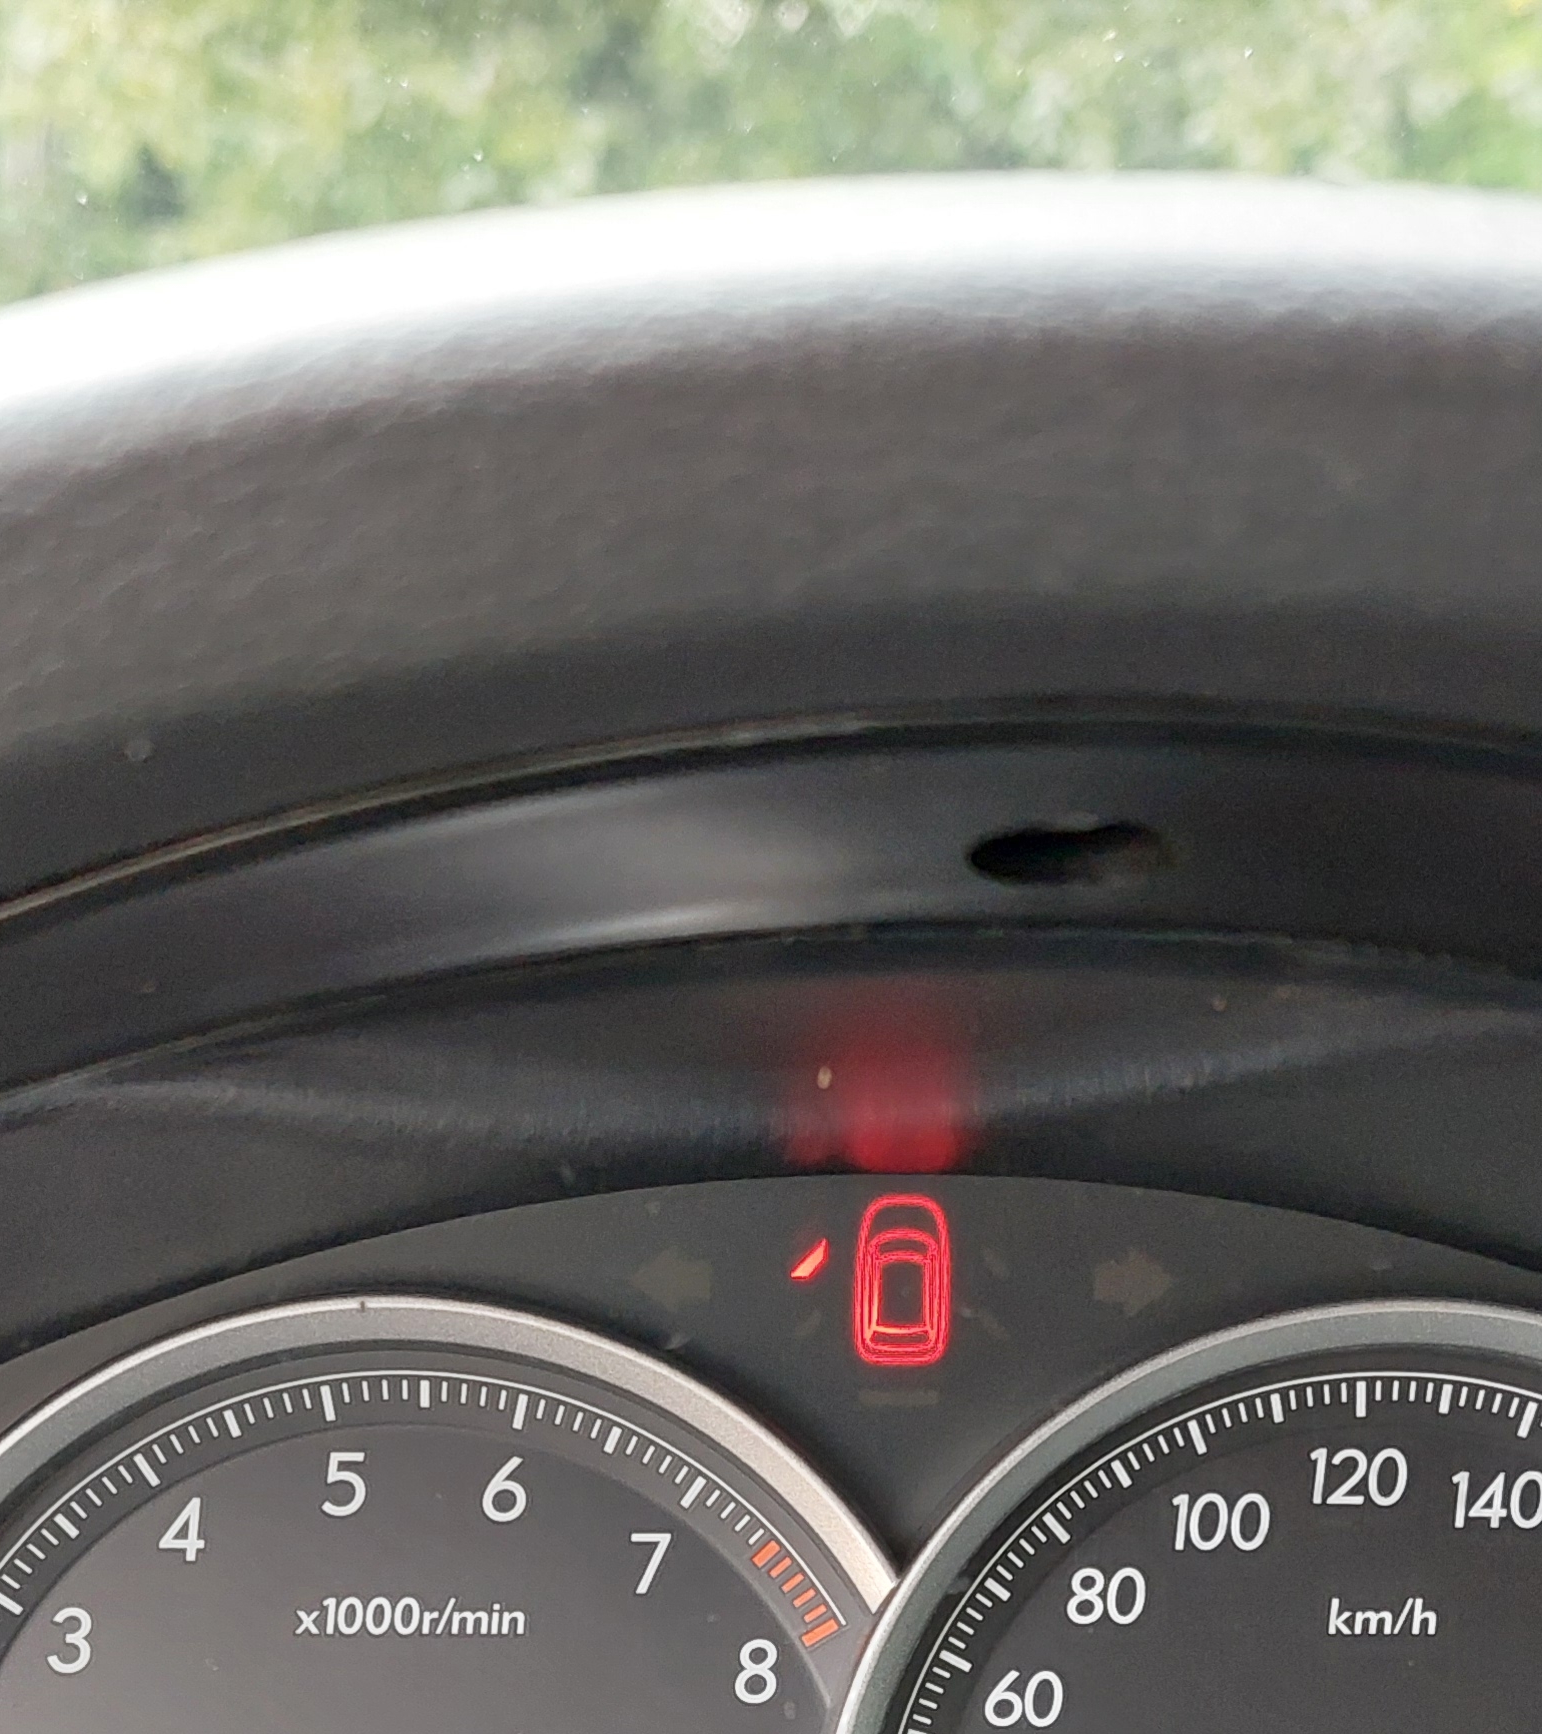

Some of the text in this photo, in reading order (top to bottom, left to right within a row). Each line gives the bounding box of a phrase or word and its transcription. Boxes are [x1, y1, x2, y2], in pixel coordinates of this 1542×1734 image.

[320, 1451, 367, 1518] 5
[481, 1455, 528, 1523] 6
[1308, 1446, 1409, 1508] 120
[157, 1496, 206, 1563] 4
[1170, 1491, 1272, 1552] 100
[629, 1531, 673, 1595] 7
[1065, 1565, 1147, 1626] 80
[1327, 1596, 1438, 1636] km/h
[45, 1605, 93, 1675] 3
[733, 1637, 779, 1705] 8
[983, 1668, 1065, 1729] 60
